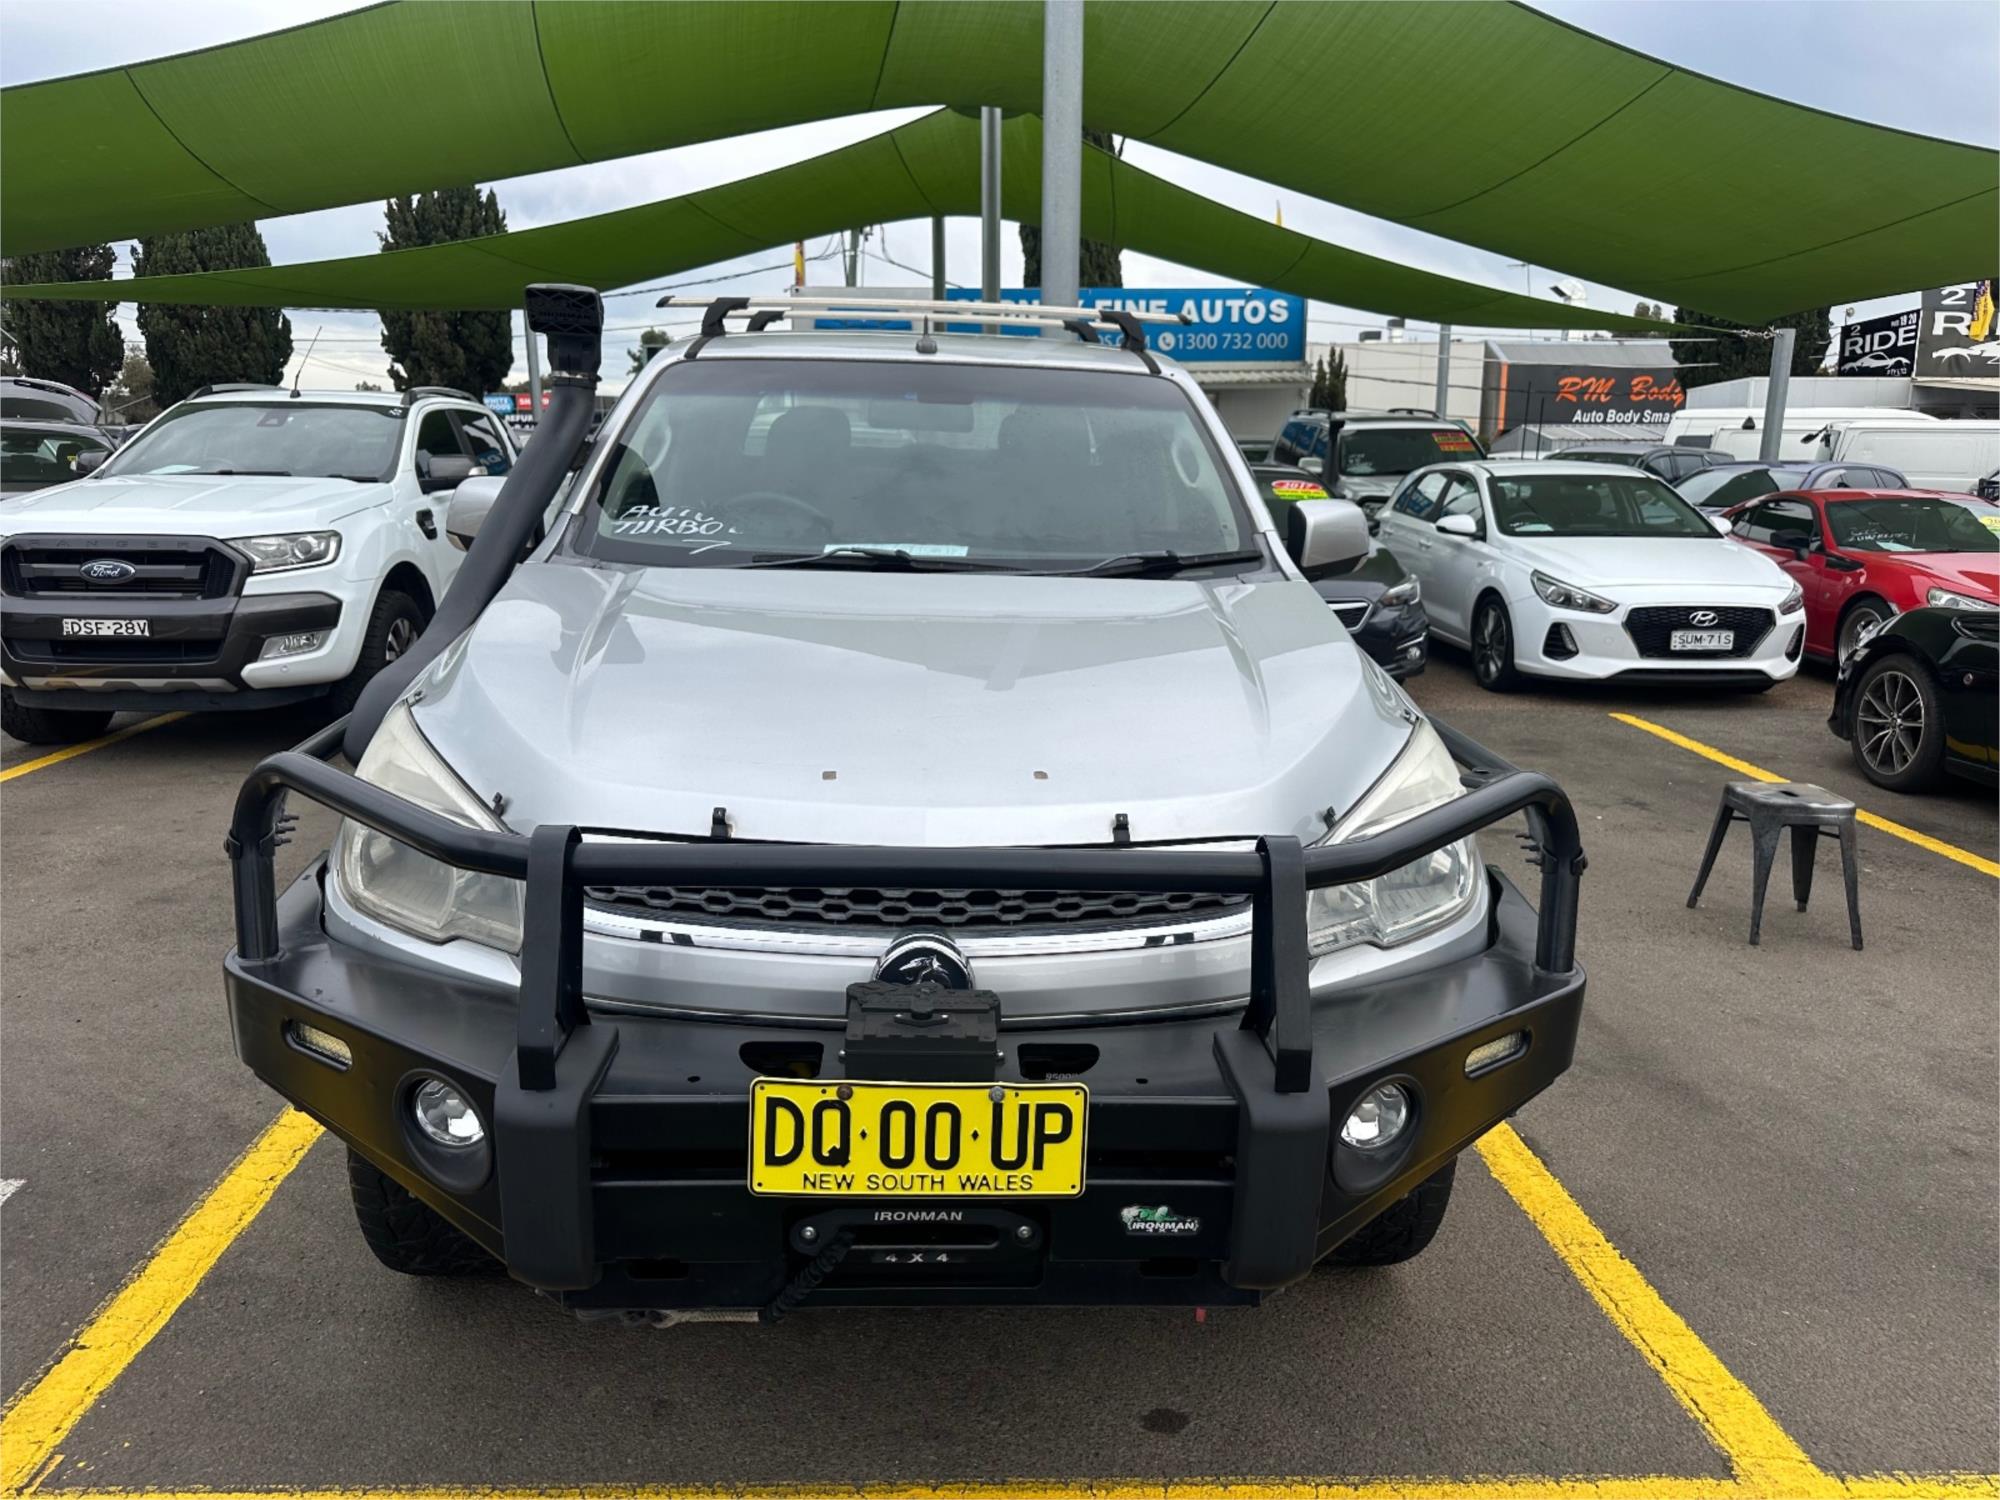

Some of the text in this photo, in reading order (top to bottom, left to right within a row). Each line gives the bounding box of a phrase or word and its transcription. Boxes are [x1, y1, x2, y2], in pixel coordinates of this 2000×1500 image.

[1941, 287, 1967, 305] 2
[1180, 298, 1289, 324] AUTOS
[1851, 325, 1861, 336] 2
[1177, 332, 1288, 350] 1300 732 000
[1844, 325, 1917, 357] RIDE
[1555, 375, 1685, 408] RM Body
[1572, 409, 1671, 425] Auto Body Sma
[28, 538, 190, 549] RANGER
[90, 564, 121, 577] Ford
[803, 1173, 1034, 1191] NEW SOUTH WALES
[873, 1211, 963, 1221] IRONMAN
[1132, 1222, 1195, 1230] IRONMAN
